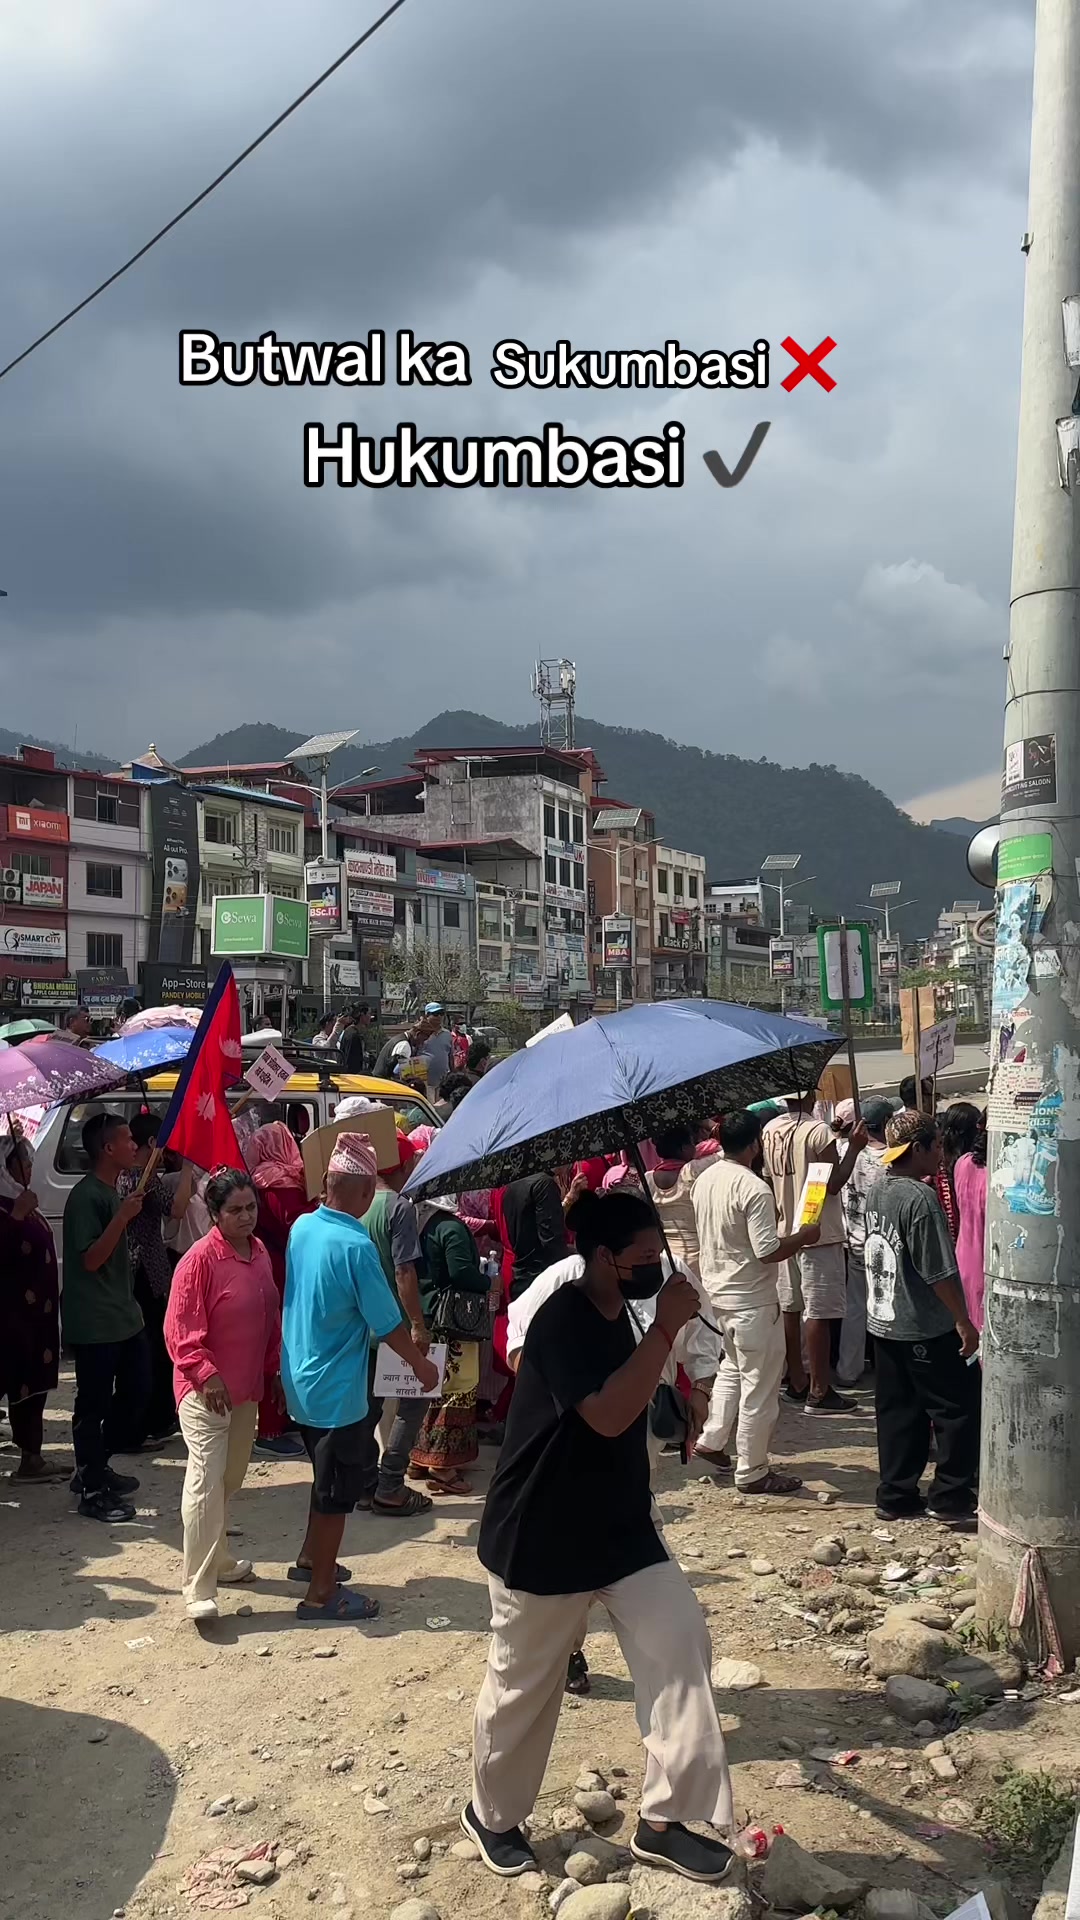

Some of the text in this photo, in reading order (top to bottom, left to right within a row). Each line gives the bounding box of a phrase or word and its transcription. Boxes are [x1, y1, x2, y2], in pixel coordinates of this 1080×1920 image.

[33, 819, 61, 831] xiaomi
[25, 881, 62, 895] JAPAN
[221, 911, 257, 924] eSewa
[310, 907, 337, 917] BSc.IT
[276, 911, 302, 928] eSewa
[20, 934, 61, 944] SMART CITY
[663, 936, 701, 950] Black Foest
[608, 948, 628, 956] MBA
[161, 991, 184, 999] PANDEY
[382, 1374, 400, 1382] ज्यान
